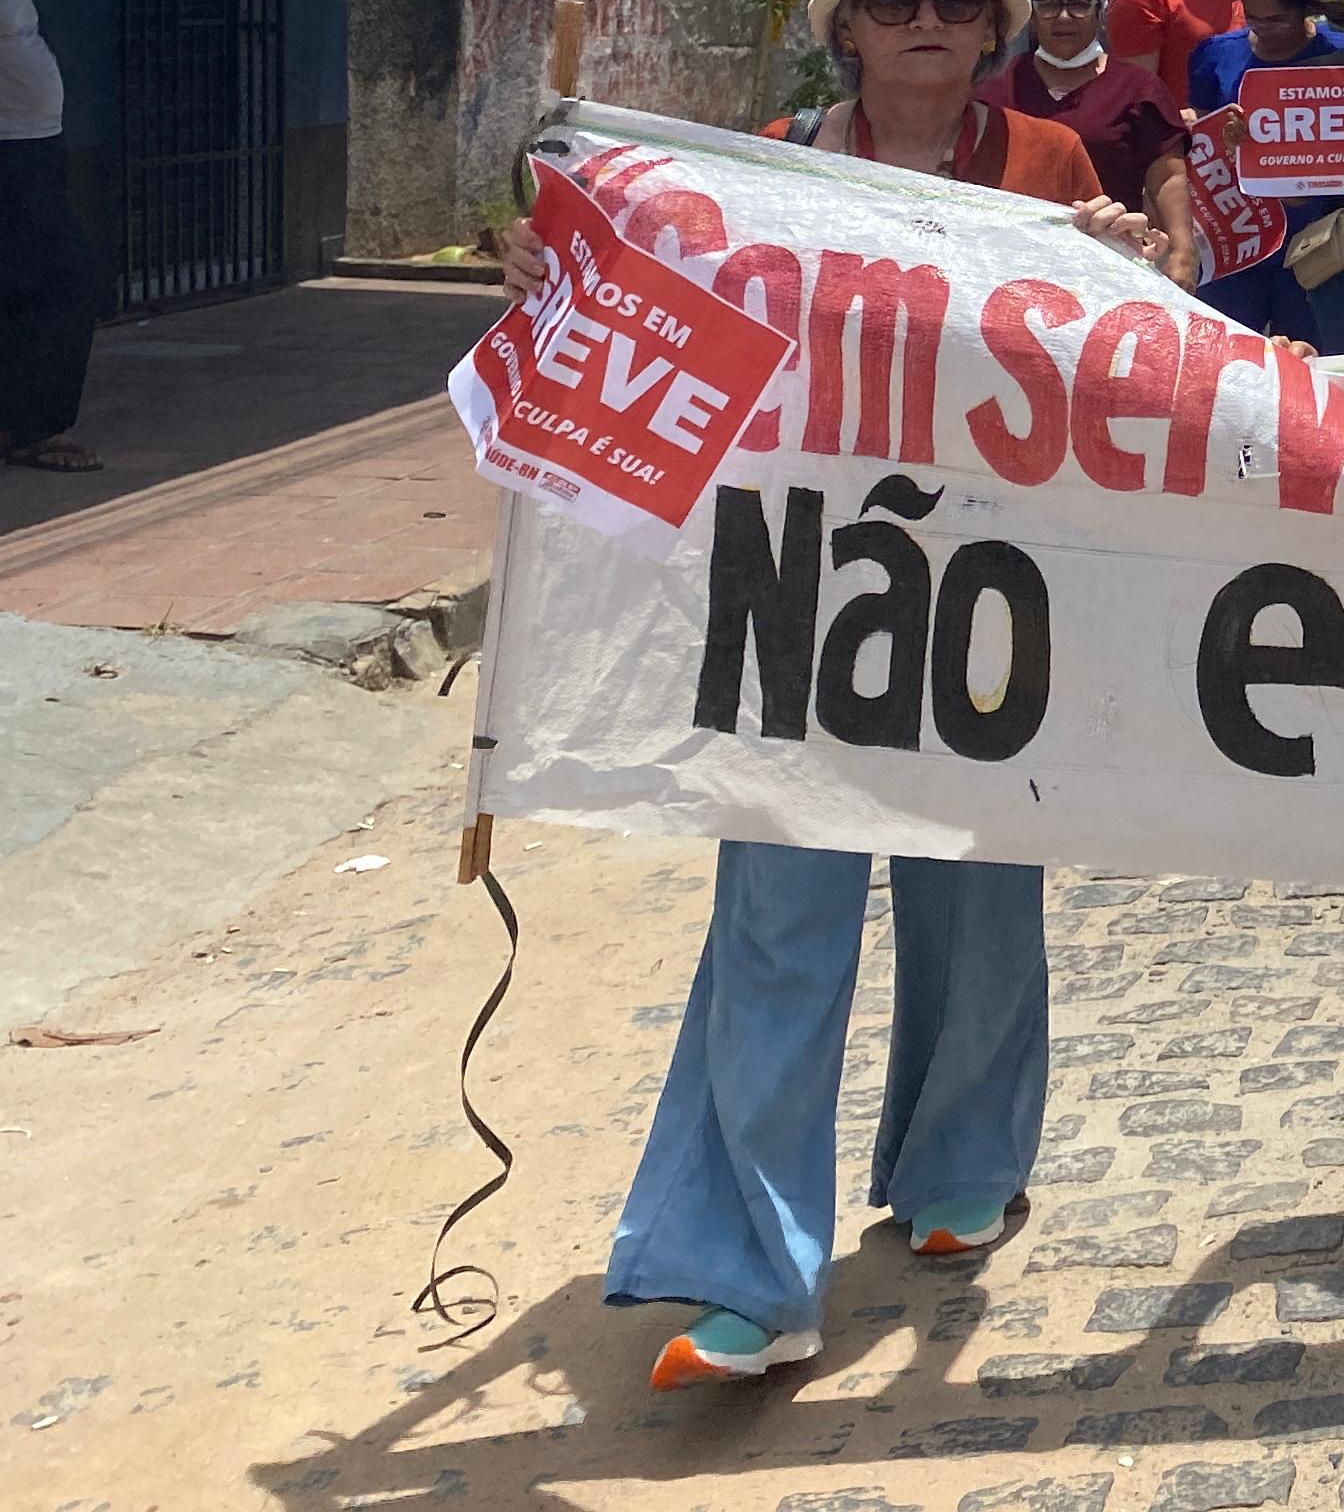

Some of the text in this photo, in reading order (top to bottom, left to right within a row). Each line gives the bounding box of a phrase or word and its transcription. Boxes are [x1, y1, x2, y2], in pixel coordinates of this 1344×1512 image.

[1259, 154, 1313, 166] GOVERNO
[1316, 154, 1324, 164] A
[1188, 133, 1261, 265] GREVE
[643, 305, 693, 350] EM
[514, 400, 590, 446] CULPA
[693, 473, 1051, 762] Não
